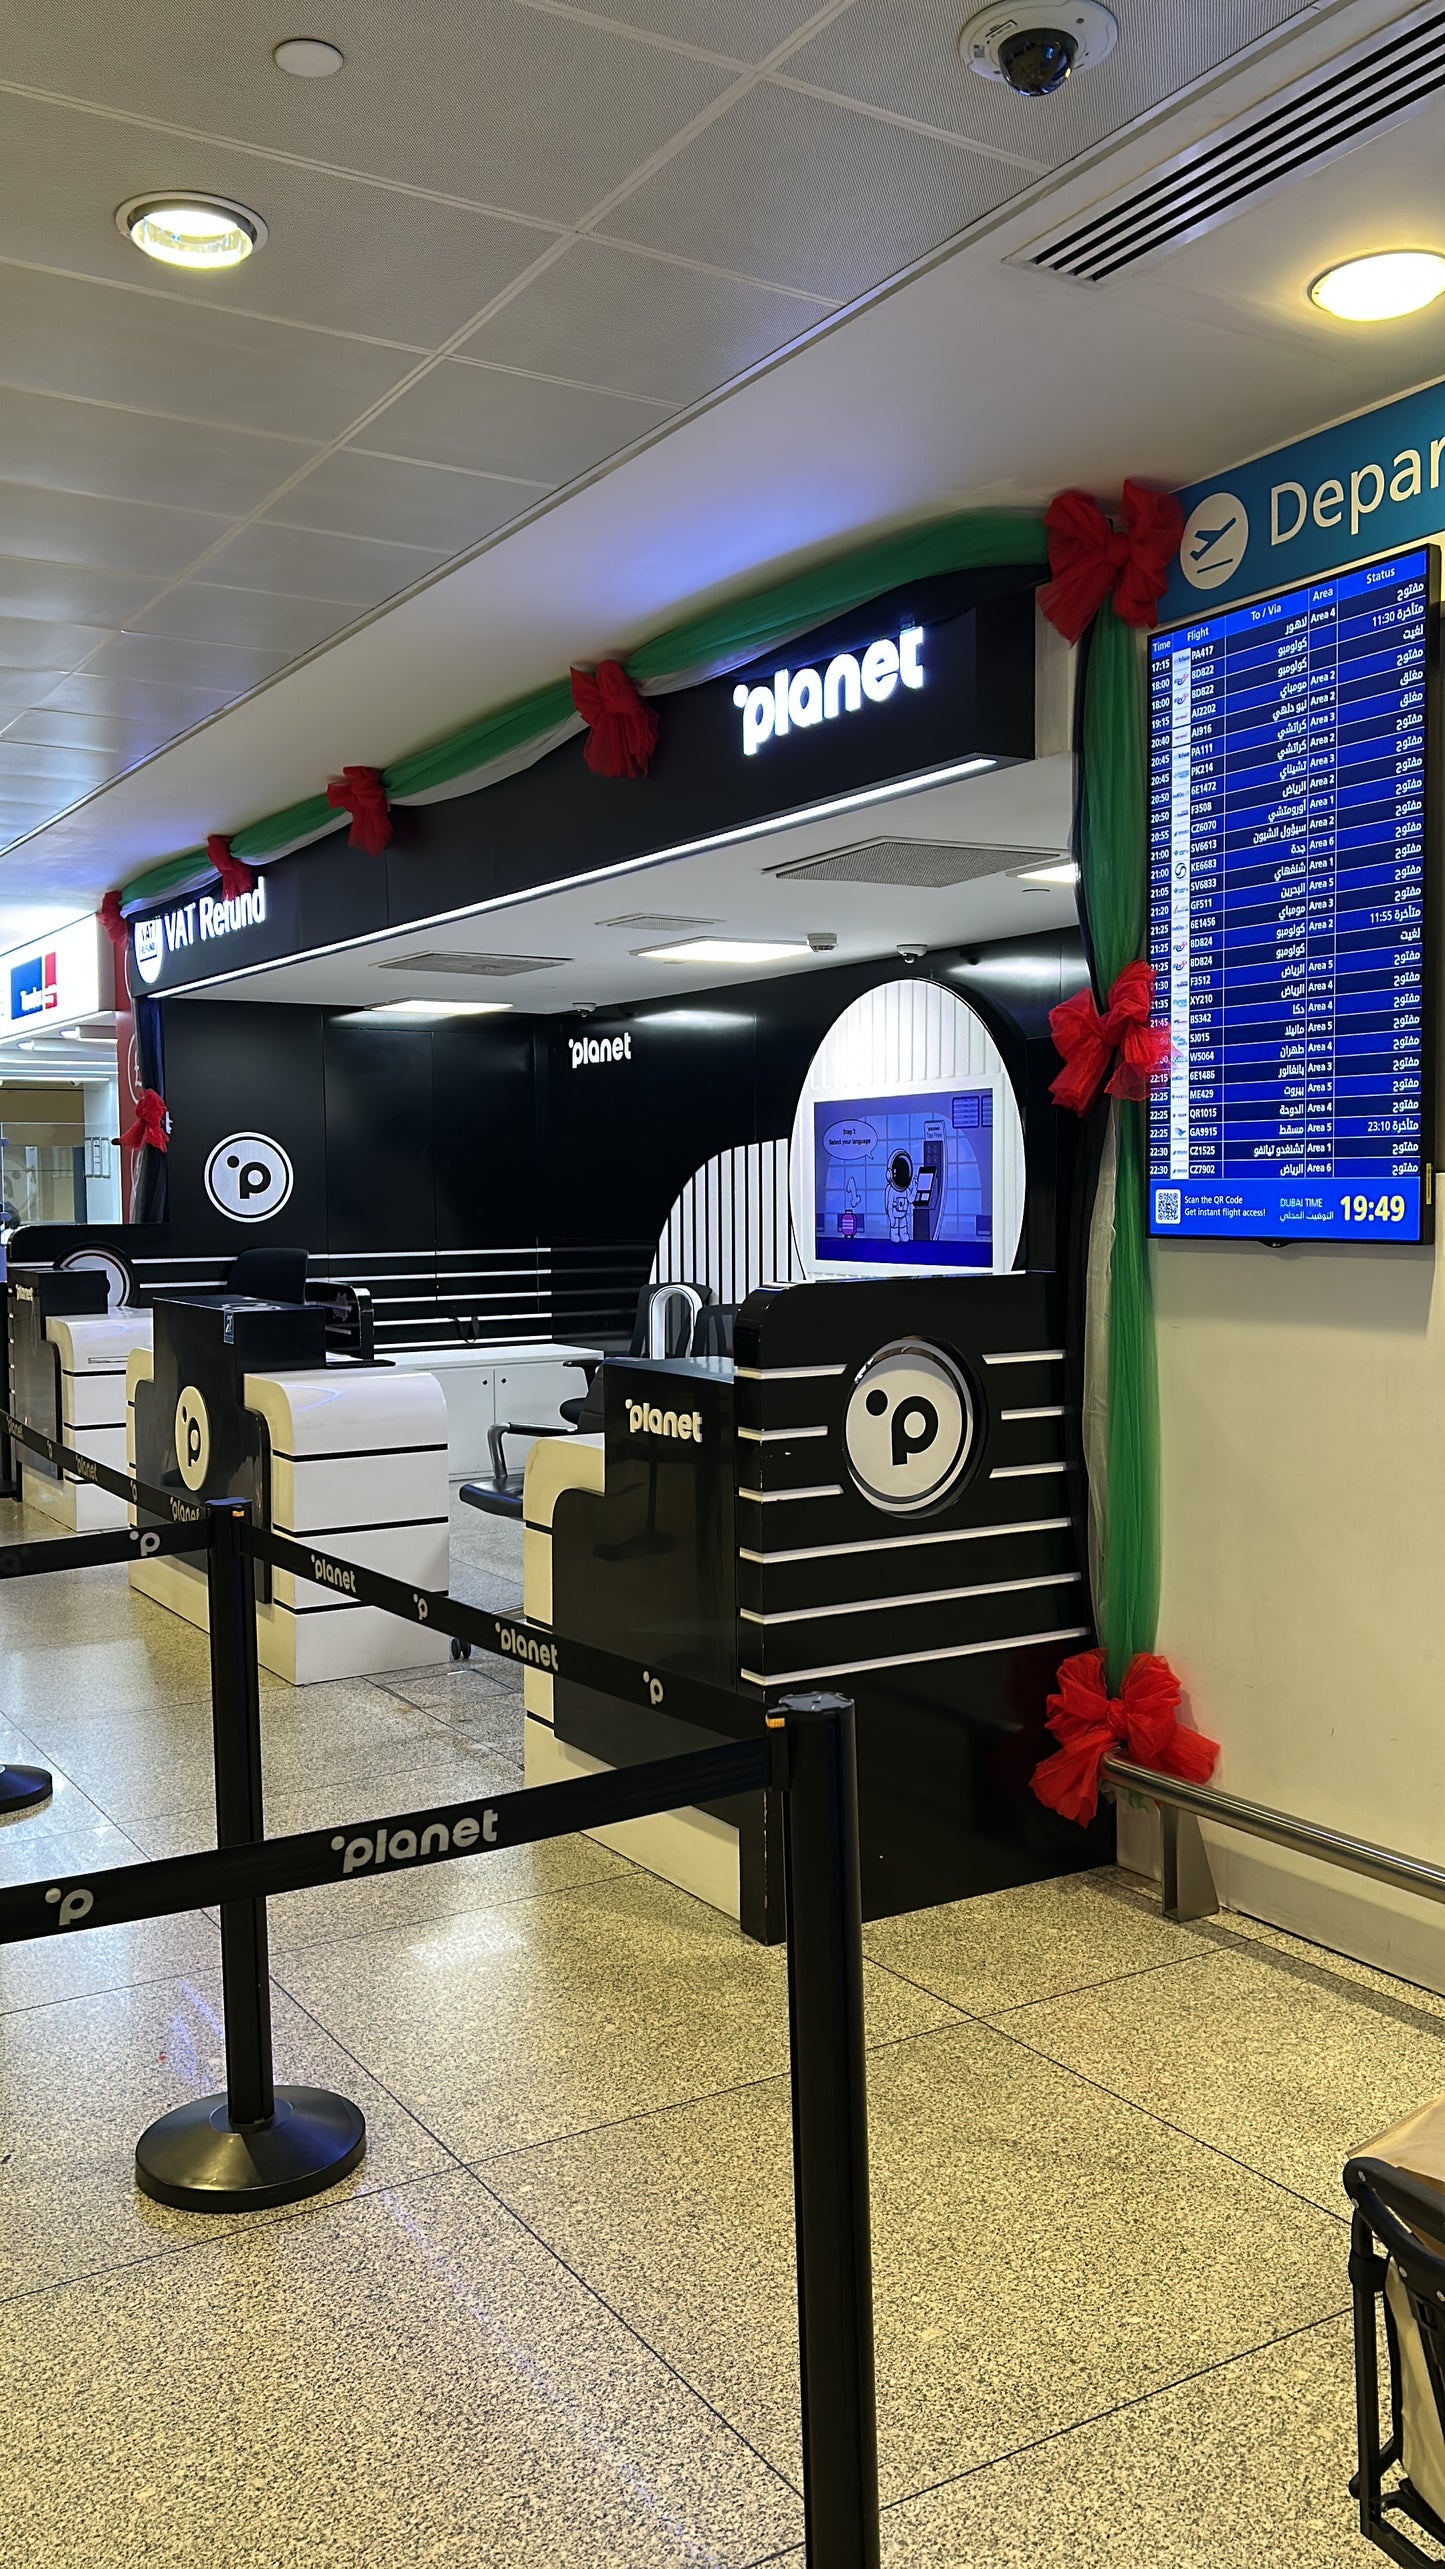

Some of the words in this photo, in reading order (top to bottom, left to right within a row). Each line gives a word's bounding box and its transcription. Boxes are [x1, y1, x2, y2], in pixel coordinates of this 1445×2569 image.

[1270, 434, 1445, 546] Depar
[1366, 566, 1396, 584] Status
[1313, 587, 1334, 602] Area
[1397, 582, 1425, 601] مفتوح
[1251, 610, 1262, 620] To
[1262, 608, 1266, 618] /
[1268, 604, 1282, 616] Via
[1310, 611, 1328, 623] Area
[1329, 607, 1335, 616] 4
[1372, 610, 1395, 626] 11:30
[1396, 602, 1424, 621] متأخرة
[1284, 615, 1307, 635] لاهور
[1402, 623, 1423, 639] لغيت
[1187, 626, 1209, 642] Flight
[1152, 639, 1171, 652] Time
[1191, 645, 1213, 660] PA417
[1278, 636, 1307, 657] كولومبو
[1151, 658, 1169, 672] 17:15
[1277, 656, 1307, 677] كولومبو
[1151, 678, 1169, 691] 18:00
[1399, 669, 1423, 686] مغلق
[732, 626, 924, 756] planet
[1279, 681, 1307, 698] مومباي
[1151, 696, 1169, 710] 18:00
[1399, 690, 1423, 707] مغلق
[1272, 702, 1294, 720] دلهي
[1151, 716, 1169, 729] 19:15
[1310, 715, 1328, 726] Area
[1329, 711, 1334, 721] 3
[1277, 718, 1306, 739] كراتشي
[1151, 735, 1169, 748] 20:40
[1191, 742, 1212, 756] PA111
[1277, 738, 1306, 760] كراتشي
[1151, 754, 1169, 767] 20:45
[1191, 762, 1213, 776] PK214
[1150, 773, 1169, 785] 20:45
[1191, 781, 1216, 795] 6E1472
[1282, 780, 1306, 797] الرياض
[1395, 778, 1422, 795] مفتوح
[1151, 792, 1169, 804] 20:50
[1191, 801, 1212, 814] F3508
[1150, 811, 1169, 823] 20:50
[1309, 818, 1327, 828] Area
[1328, 815, 1334, 825] 2
[1190, 819, 1216, 833] CZ6070
[1150, 829, 1169, 842] 20:55
[1190, 839, 1216, 852] SV6613
[1290, 843, 1306, 854] جدة
[1150, 848, 1169, 860] 21:00
[1190, 858, 1216, 872] KE6683
[1394, 864, 1421, 880] مفتوح
[1150, 868, 1169, 879] 21:00
[1190, 878, 1216, 891] SV6833
[1280, 882, 1305, 898] البحرين
[1150, 886, 1168, 898] 21:05
[1150, 905, 1168, 916] 21:20
[1190, 898, 1211, 909] GF511
[1278, 905, 1305, 920] مومباي
[1370, 910, 1392, 923] 11:55
[1394, 904, 1421, 921] متأخرة
[164, 904, 196, 952] VAT
[1150, 924, 1168, 935] 21:25
[1190, 916, 1215, 929] 6E1456
[1308, 921, 1326, 930] Area
[1328, 918, 1333, 927] 2
[140, 922, 156, 941] VAT
[1276, 922, 1305, 939] كولومبو
[1400, 927, 1420, 941] لغيت
[1150, 942, 1168, 954] 21:25
[1276, 942, 1305, 959] كولومبو
[1280, 963, 1304, 978] الرياض
[1190, 974, 1210, 986] F3512
[1280, 983, 1304, 998] الرياض
[1189, 993, 1212, 1005] XY210
[1307, 1002, 1326, 1011] Area
[1327, 1000, 1332, 1009] 4
[1393, 993, 1420, 1008] مفتوح
[1292, 1003, 1304, 1014] دكا
[1284, 1023, 1304, 1036] مانيلا
[568, 1031, 632, 1068] planet
[1189, 1050, 1214, 1061] W5064
[1280, 1044, 1304, 1058] طهران
[1307, 1062, 1325, 1072] Area
[1326, 1061, 1332, 1070] 3
[1150, 1070, 1169, 1083] 22:15
[1189, 1069, 1215, 1080] 6E1486
[1283, 1086, 1304, 1097] بيروت
[1392, 1078, 1419, 1092] مفتوح
[1150, 1091, 1168, 1101] 22:25
[1189, 1089, 1213, 1099] ME429
[1149, 1110, 1168, 1120] 22:25
[1189, 1107, 1216, 1119] QR1015
[1279, 1103, 1303, 1116] الدوحة
[1189, 1126, 1217, 1136] GA9915
[1278, 1124, 1304, 1134] مسقط
[1367, 1120, 1390, 1131] 23:10
[1392, 1117, 1418, 1133] متأخرة
[1149, 1128, 1168, 1138] 22:25
[1150, 1147, 1168, 1156] 22:30
[1189, 1145, 1215, 1155] CZ1525
[1149, 1165, 1168, 1174] 22:30
[1189, 1164, 1215, 1174] CZ7902
[1280, 1163, 1303, 1176] الرياض
[1306, 1163, 1325, 1172] Area
[1326, 1162, 1331, 1172] 6
[1392, 1162, 1418, 1176] مفتوح
[1184, 1196, 1199, 1204] Scan
[1201, 1196, 1212, 1204] the
[1214, 1196, 1224, 1205] QR
[1225, 1196, 1243, 1204] Code
[1280, 1198, 1303, 1207] DUBAI
[1305, 1198, 1323, 1208] TIME
[1198, 1208, 1221, 1216] instant
[1223, 1208, 1241, 1218] flight
[1340, 1195, 1405, 1222] 19:49
[625, 1398, 703, 1444] planet
[310, 1554, 357, 1593] planet
[495, 1622, 559, 1672] planet
[331, 1808, 498, 1874] planet
